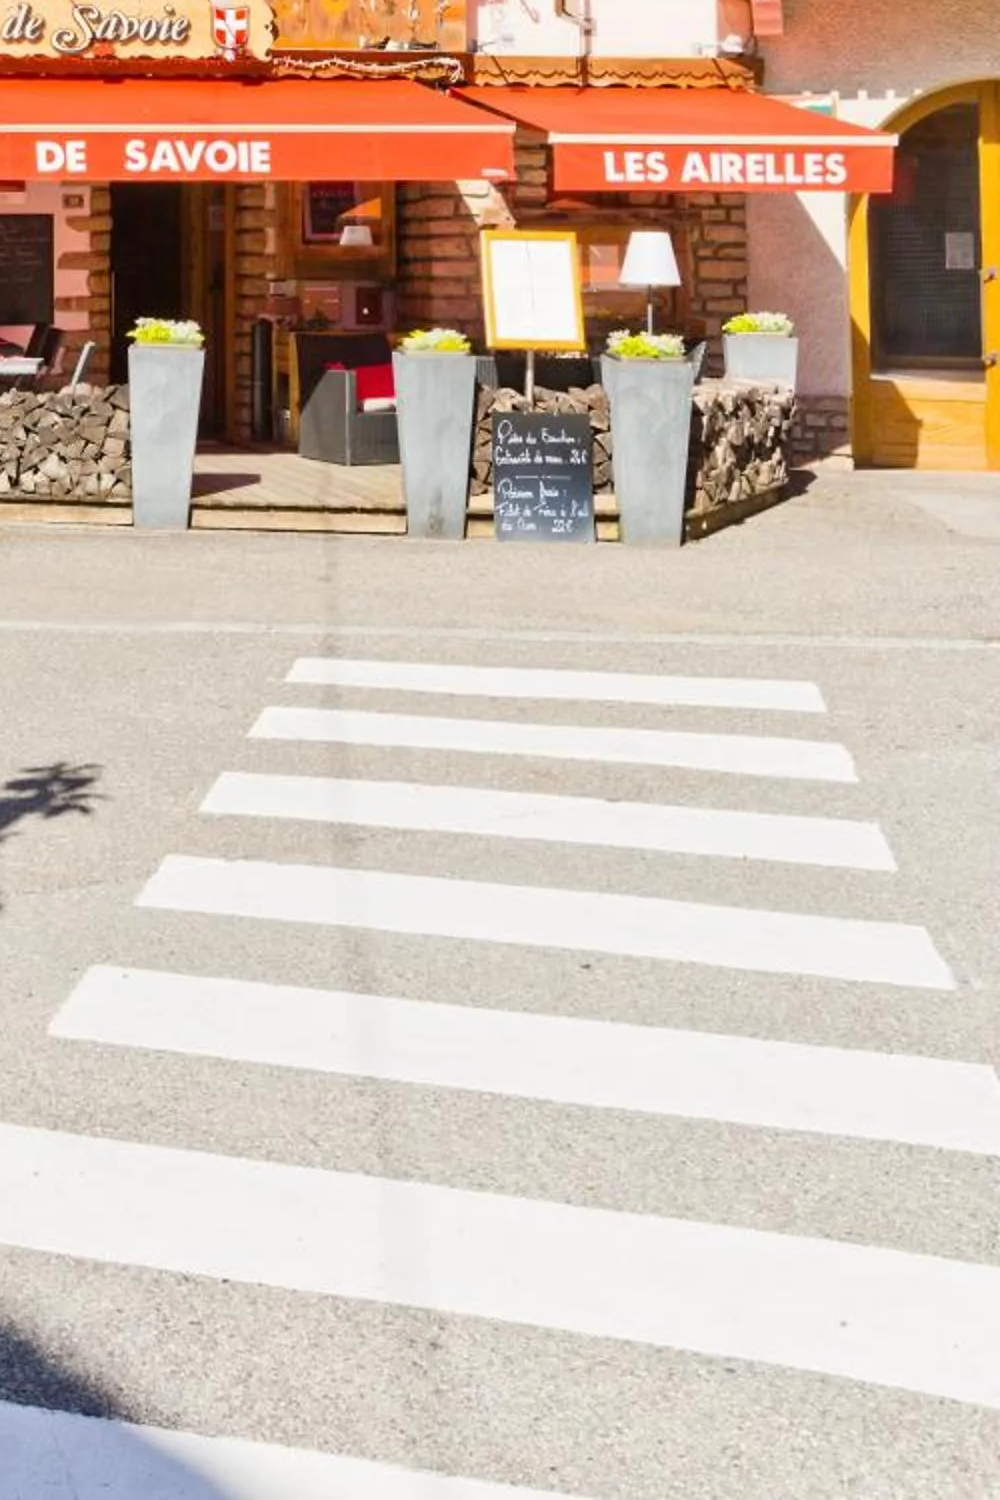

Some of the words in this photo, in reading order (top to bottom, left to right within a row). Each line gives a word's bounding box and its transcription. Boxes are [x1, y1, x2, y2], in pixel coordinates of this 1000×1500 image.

[0, 4, 45, 41] de
[51, 4, 191, 53] Savoie
[35, 140, 87, 173] DE
[124, 140, 271, 173] SAVOIE
[603, 151, 669, 183] LES
[680, 151, 847, 185] AIRELLES
